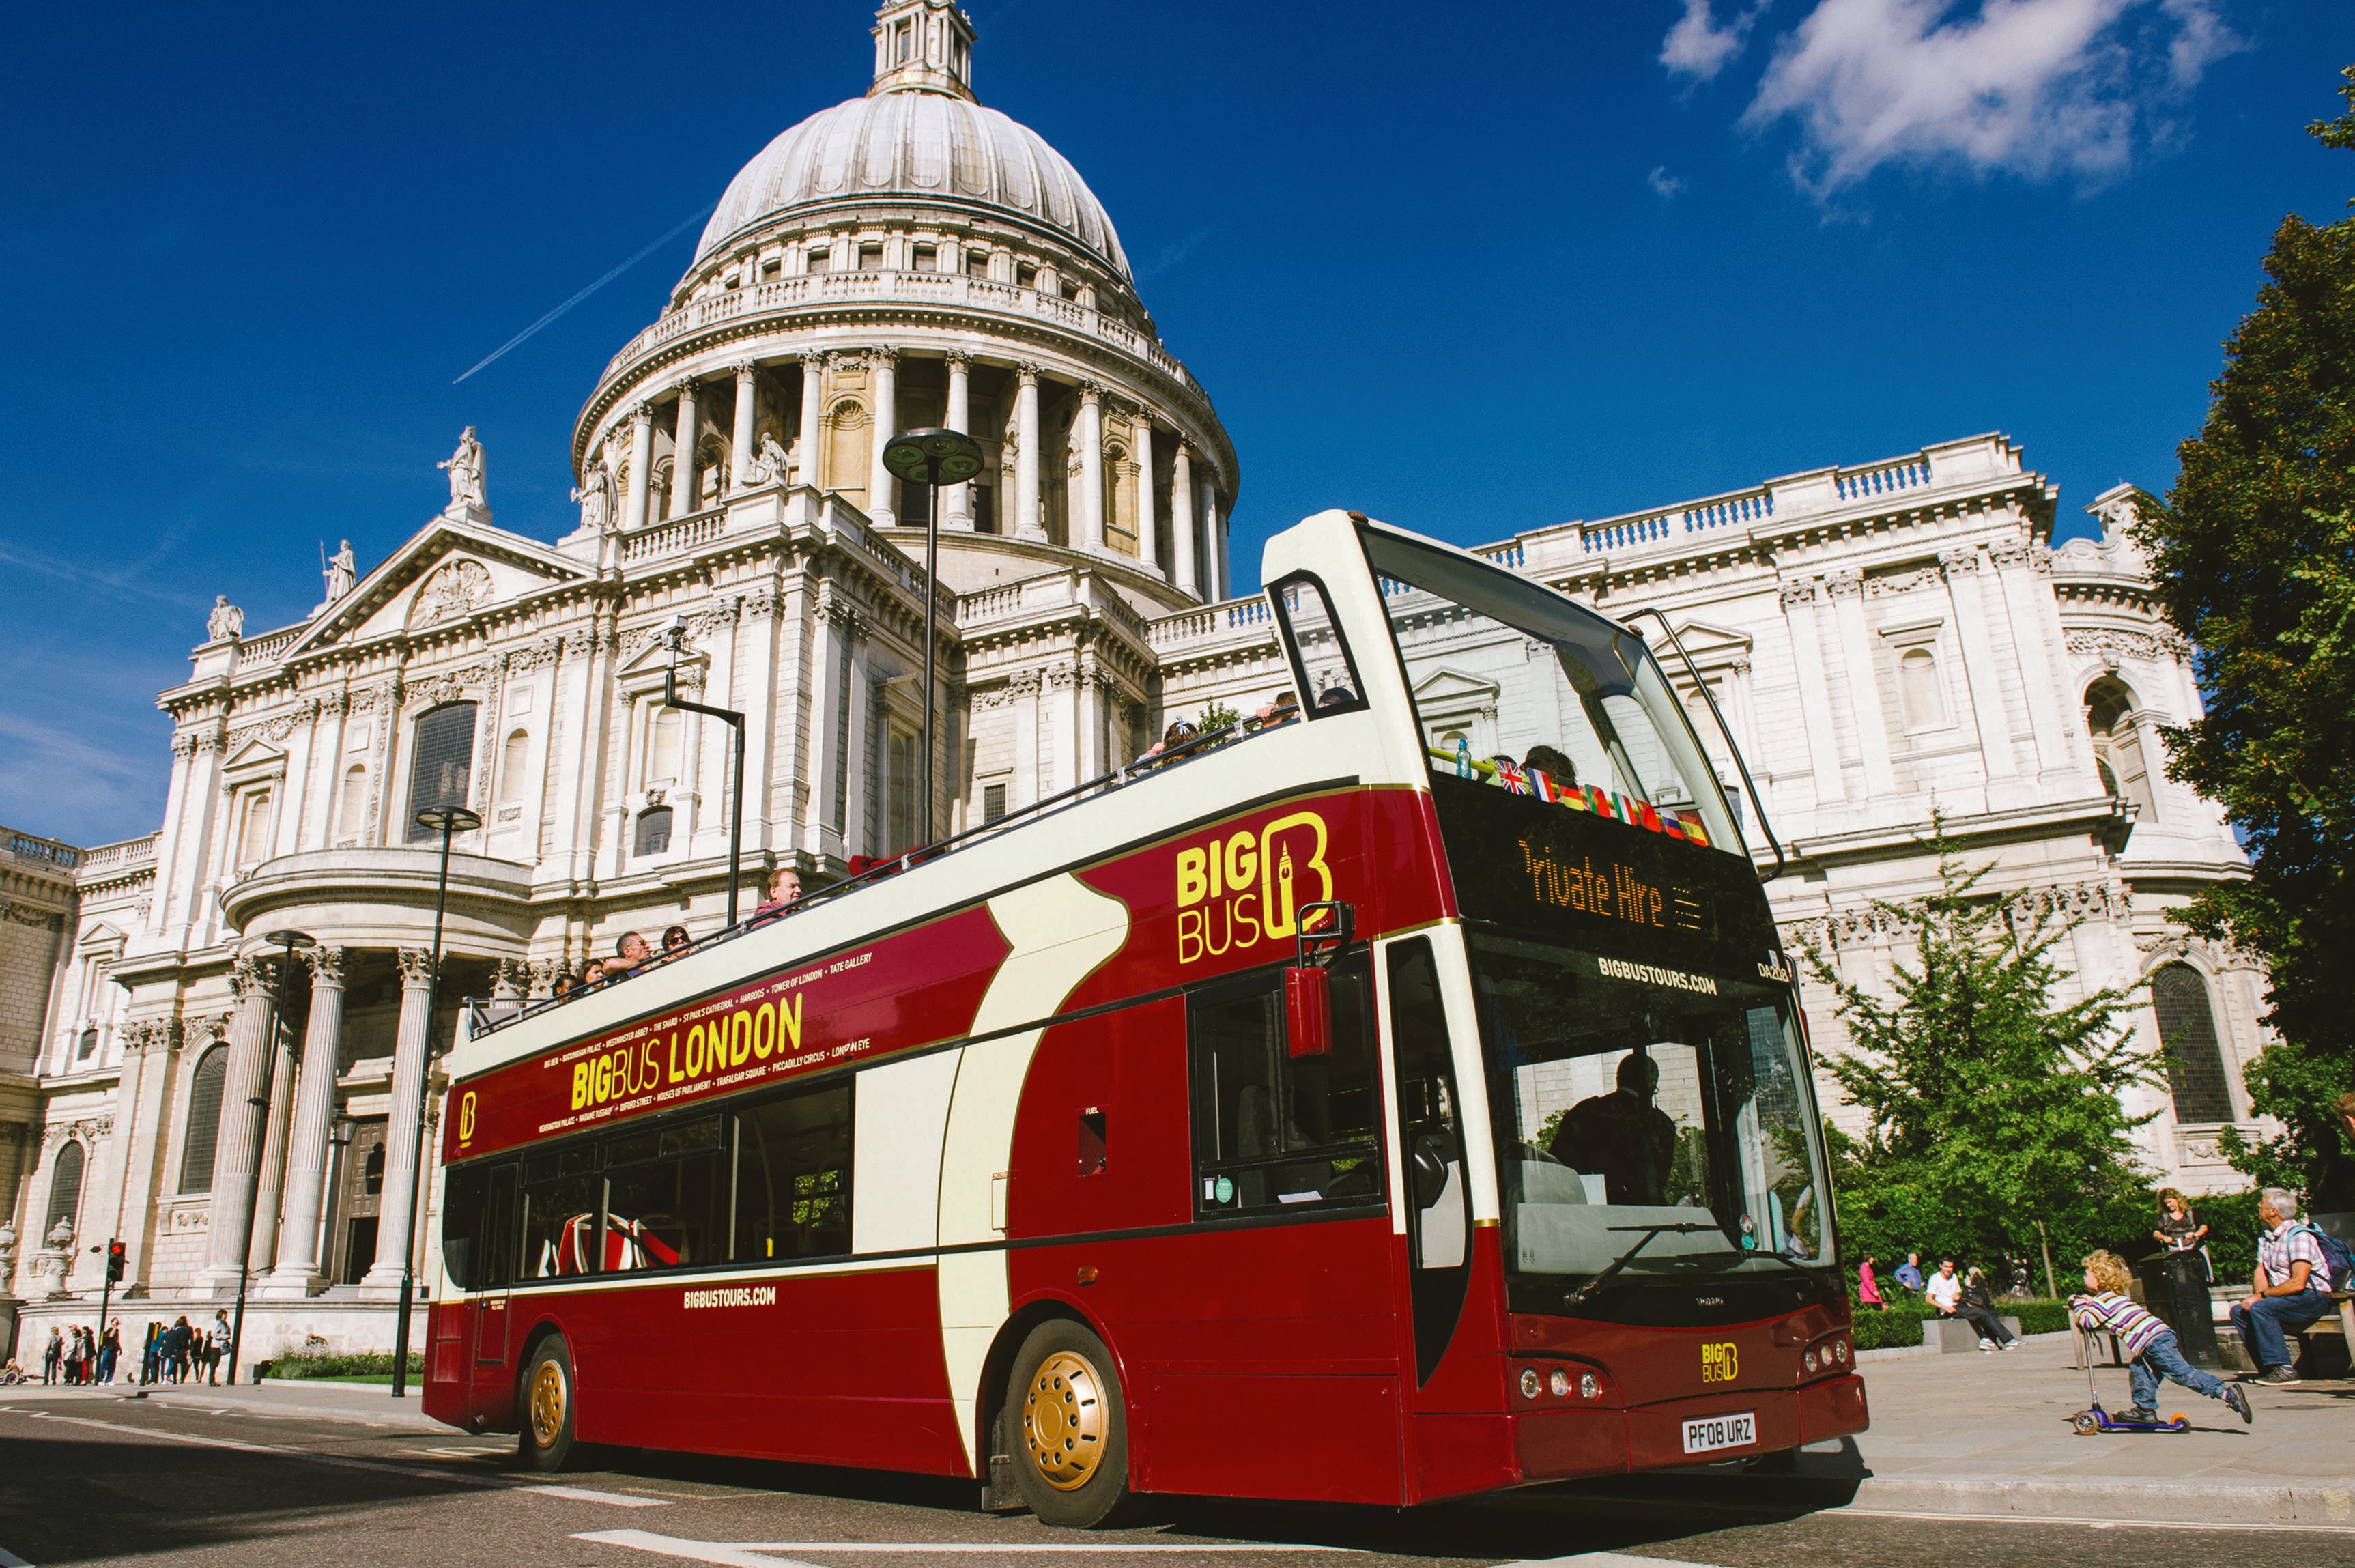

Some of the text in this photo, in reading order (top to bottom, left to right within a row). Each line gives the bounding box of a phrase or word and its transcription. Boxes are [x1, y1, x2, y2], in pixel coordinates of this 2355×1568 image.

[1177, 831, 1257, 908] BIG
[1614, 864, 1665, 927] Hire
[1178, 893, 1260, 965] BUS
[1598, 957, 1717, 995] BIGBUSTOURS.COM
[1757, 963, 1789, 982] DA208
[587, 1042, 602, 1055] PALACE
[605, 1031, 634, 1049] WESTMINSTER
[634, 1027, 648, 1038] ABBEY
[653, 1022, 662, 1032] THE
[663, 1017, 678, 1029] SHARD
[683, 1014, 689, 1023] ST
[689, 1008, 706, 1021] PAUL'S
[706, 999, 734, 1015] CATHEDRAL
[740, 988, 765, 1004] HARRODS
[771, 980, 790, 994] TOWER
[790, 977, 799, 987] OF
[799, 969, 823, 985] LONDON
[829, 961, 844, 975] TATE
[844, 952, 872, 969] GALLERY
[571, 992, 803, 1111] BIGBUS LONDON
[579, 1111, 595, 1123] MADAME
[620, 1100, 636, 1112] OXFORD
[636, 1095, 653, 1107] STREET
[657, 1089, 674, 1102] HOUSES
[675, 1087, 683, 1097] OF
[683, 1079, 711, 1095] PARLIAMENT
[717, 1071, 745, 1087] TRAFALGAR
[745, 1066, 767, 1079] SQUARE
[773, 1056, 803, 1072] PICCADILLY
[803, 1051, 825, 1064] CIRCUS
[858, 1038, 870, 1051] EYE
[1086, 1107, 1099, 1115] FUEL
[684, 1286, 776, 1309] BIGBUSTOURS.COM
[1702, 1343, 1722, 1364] BIG
[1703, 1364, 1723, 1382] BUS
[1688, 1418, 1751, 1448] PF08 URZ
